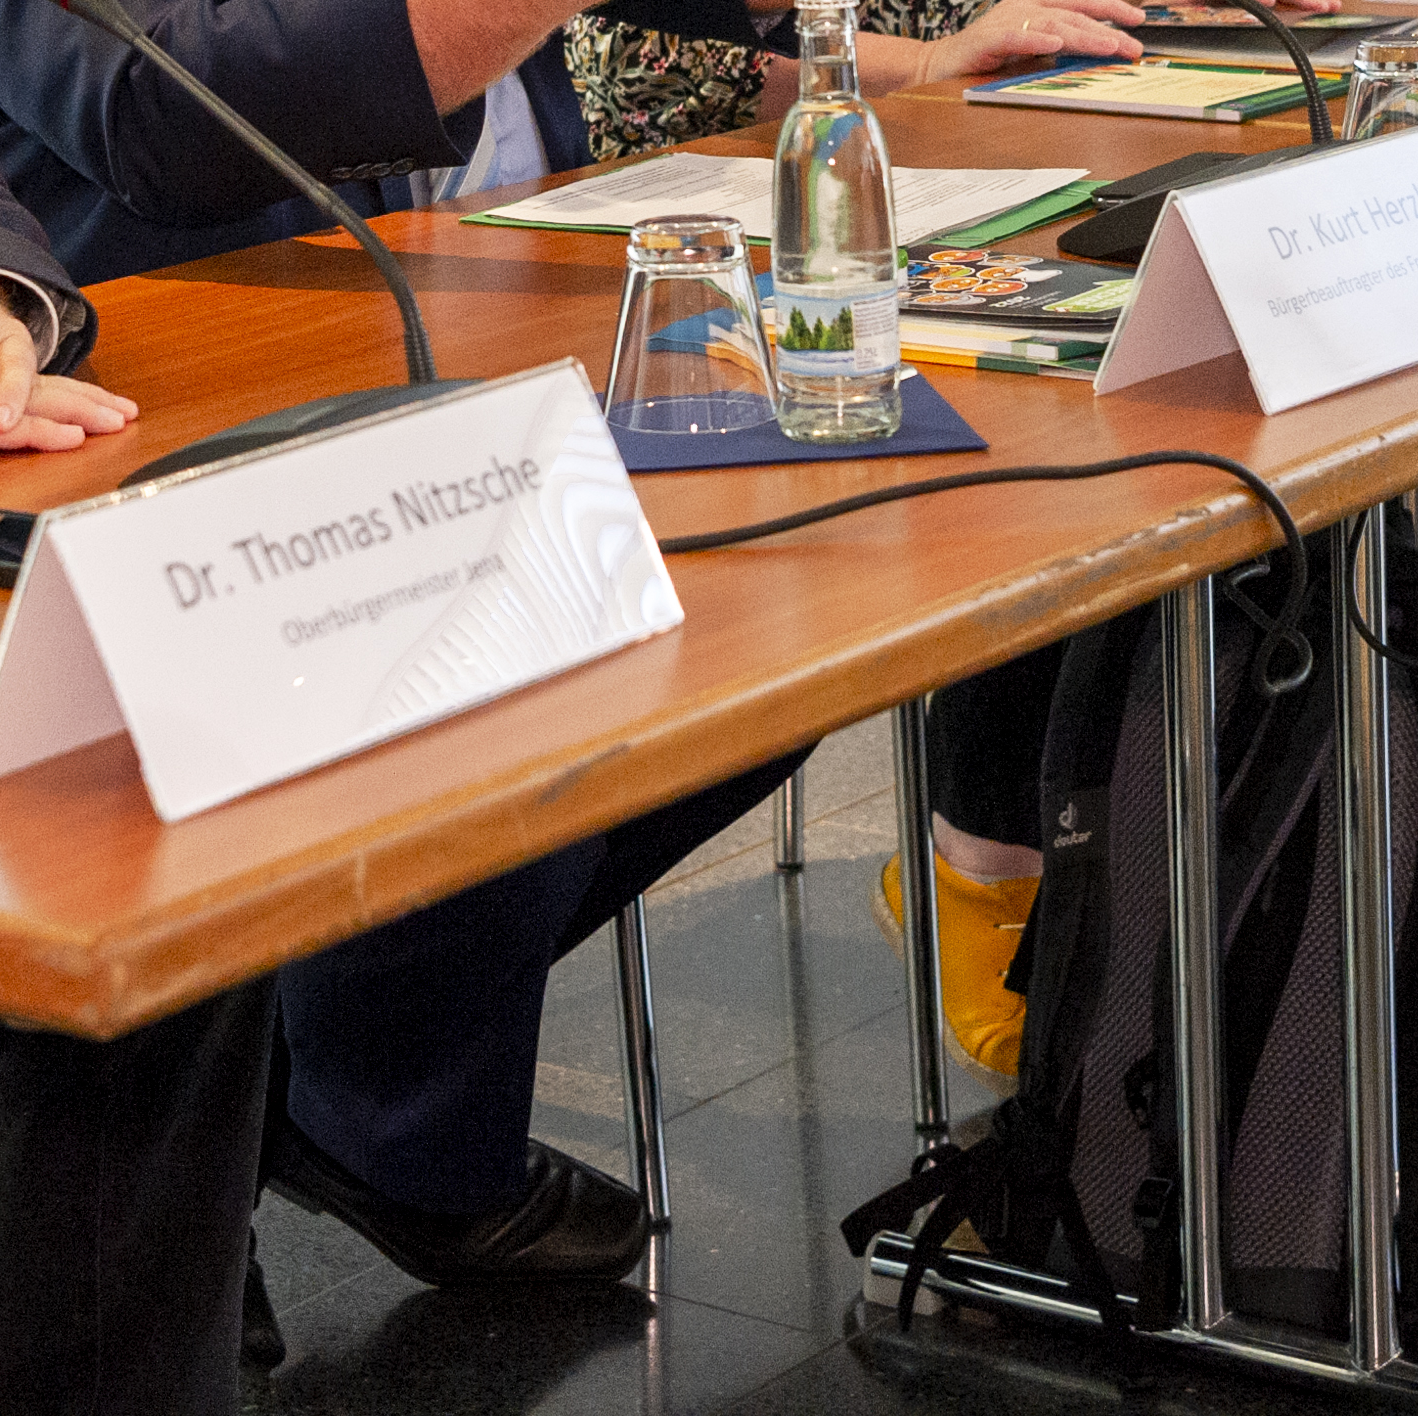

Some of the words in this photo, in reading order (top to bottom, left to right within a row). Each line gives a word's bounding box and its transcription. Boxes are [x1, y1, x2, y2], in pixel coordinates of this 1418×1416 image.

[1268, 225, 1313, 260] Dr.
[1309, 206, 1369, 248] Kurt
[1267, 268, 1384, 318] Bürgerbeauftragter
[1386, 260, 1408, 281] des
[163, 557, 235, 611] Dr.
[231, 506, 393, 585] Thomas
[391, 455, 542, 533] Nitzsche
[282, 569, 460, 648] Oberbürgermeister
